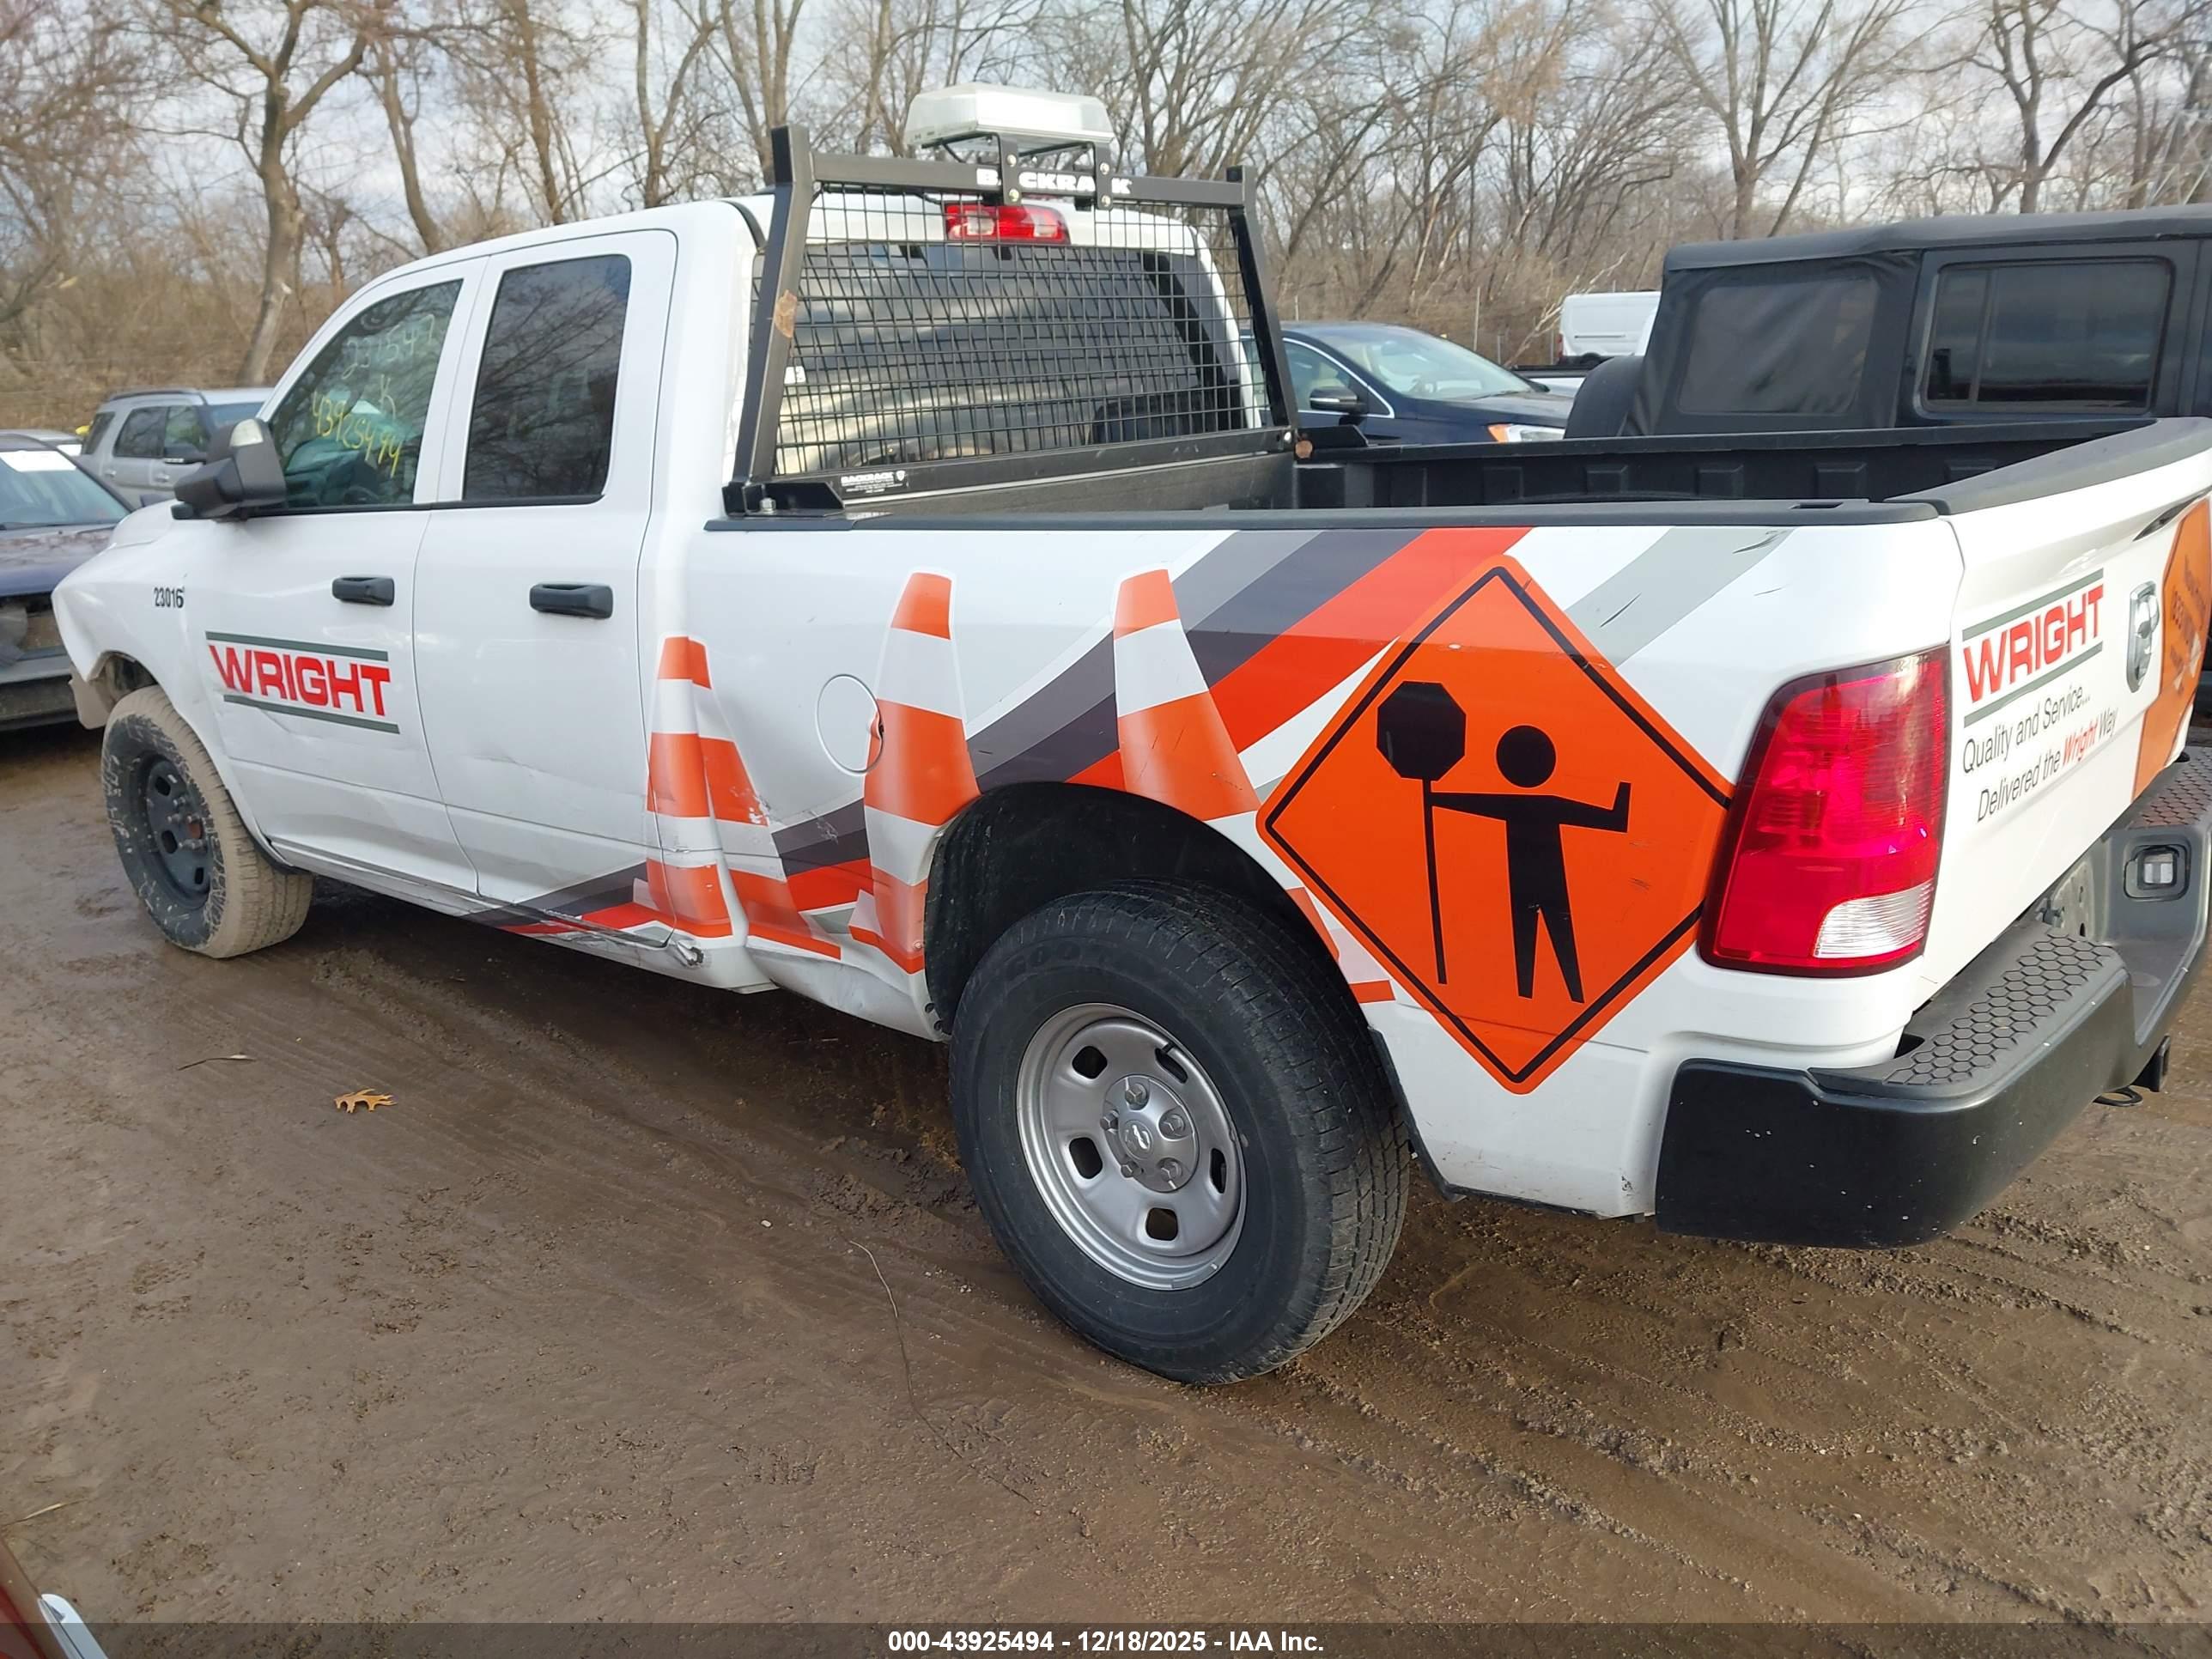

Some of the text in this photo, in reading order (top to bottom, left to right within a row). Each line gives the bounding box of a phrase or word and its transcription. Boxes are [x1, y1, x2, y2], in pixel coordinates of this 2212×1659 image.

[976, 168, 1131, 194] BCKRAK
[154, 586, 184, 608] 23016
[209, 645, 391, 716] WRIGHT
[1963, 584, 2104, 703] WRIGHT
[1963, 684, 2090, 774] Quality and Service...
[1978, 707, 2118, 823] Delivered the Wright Way
